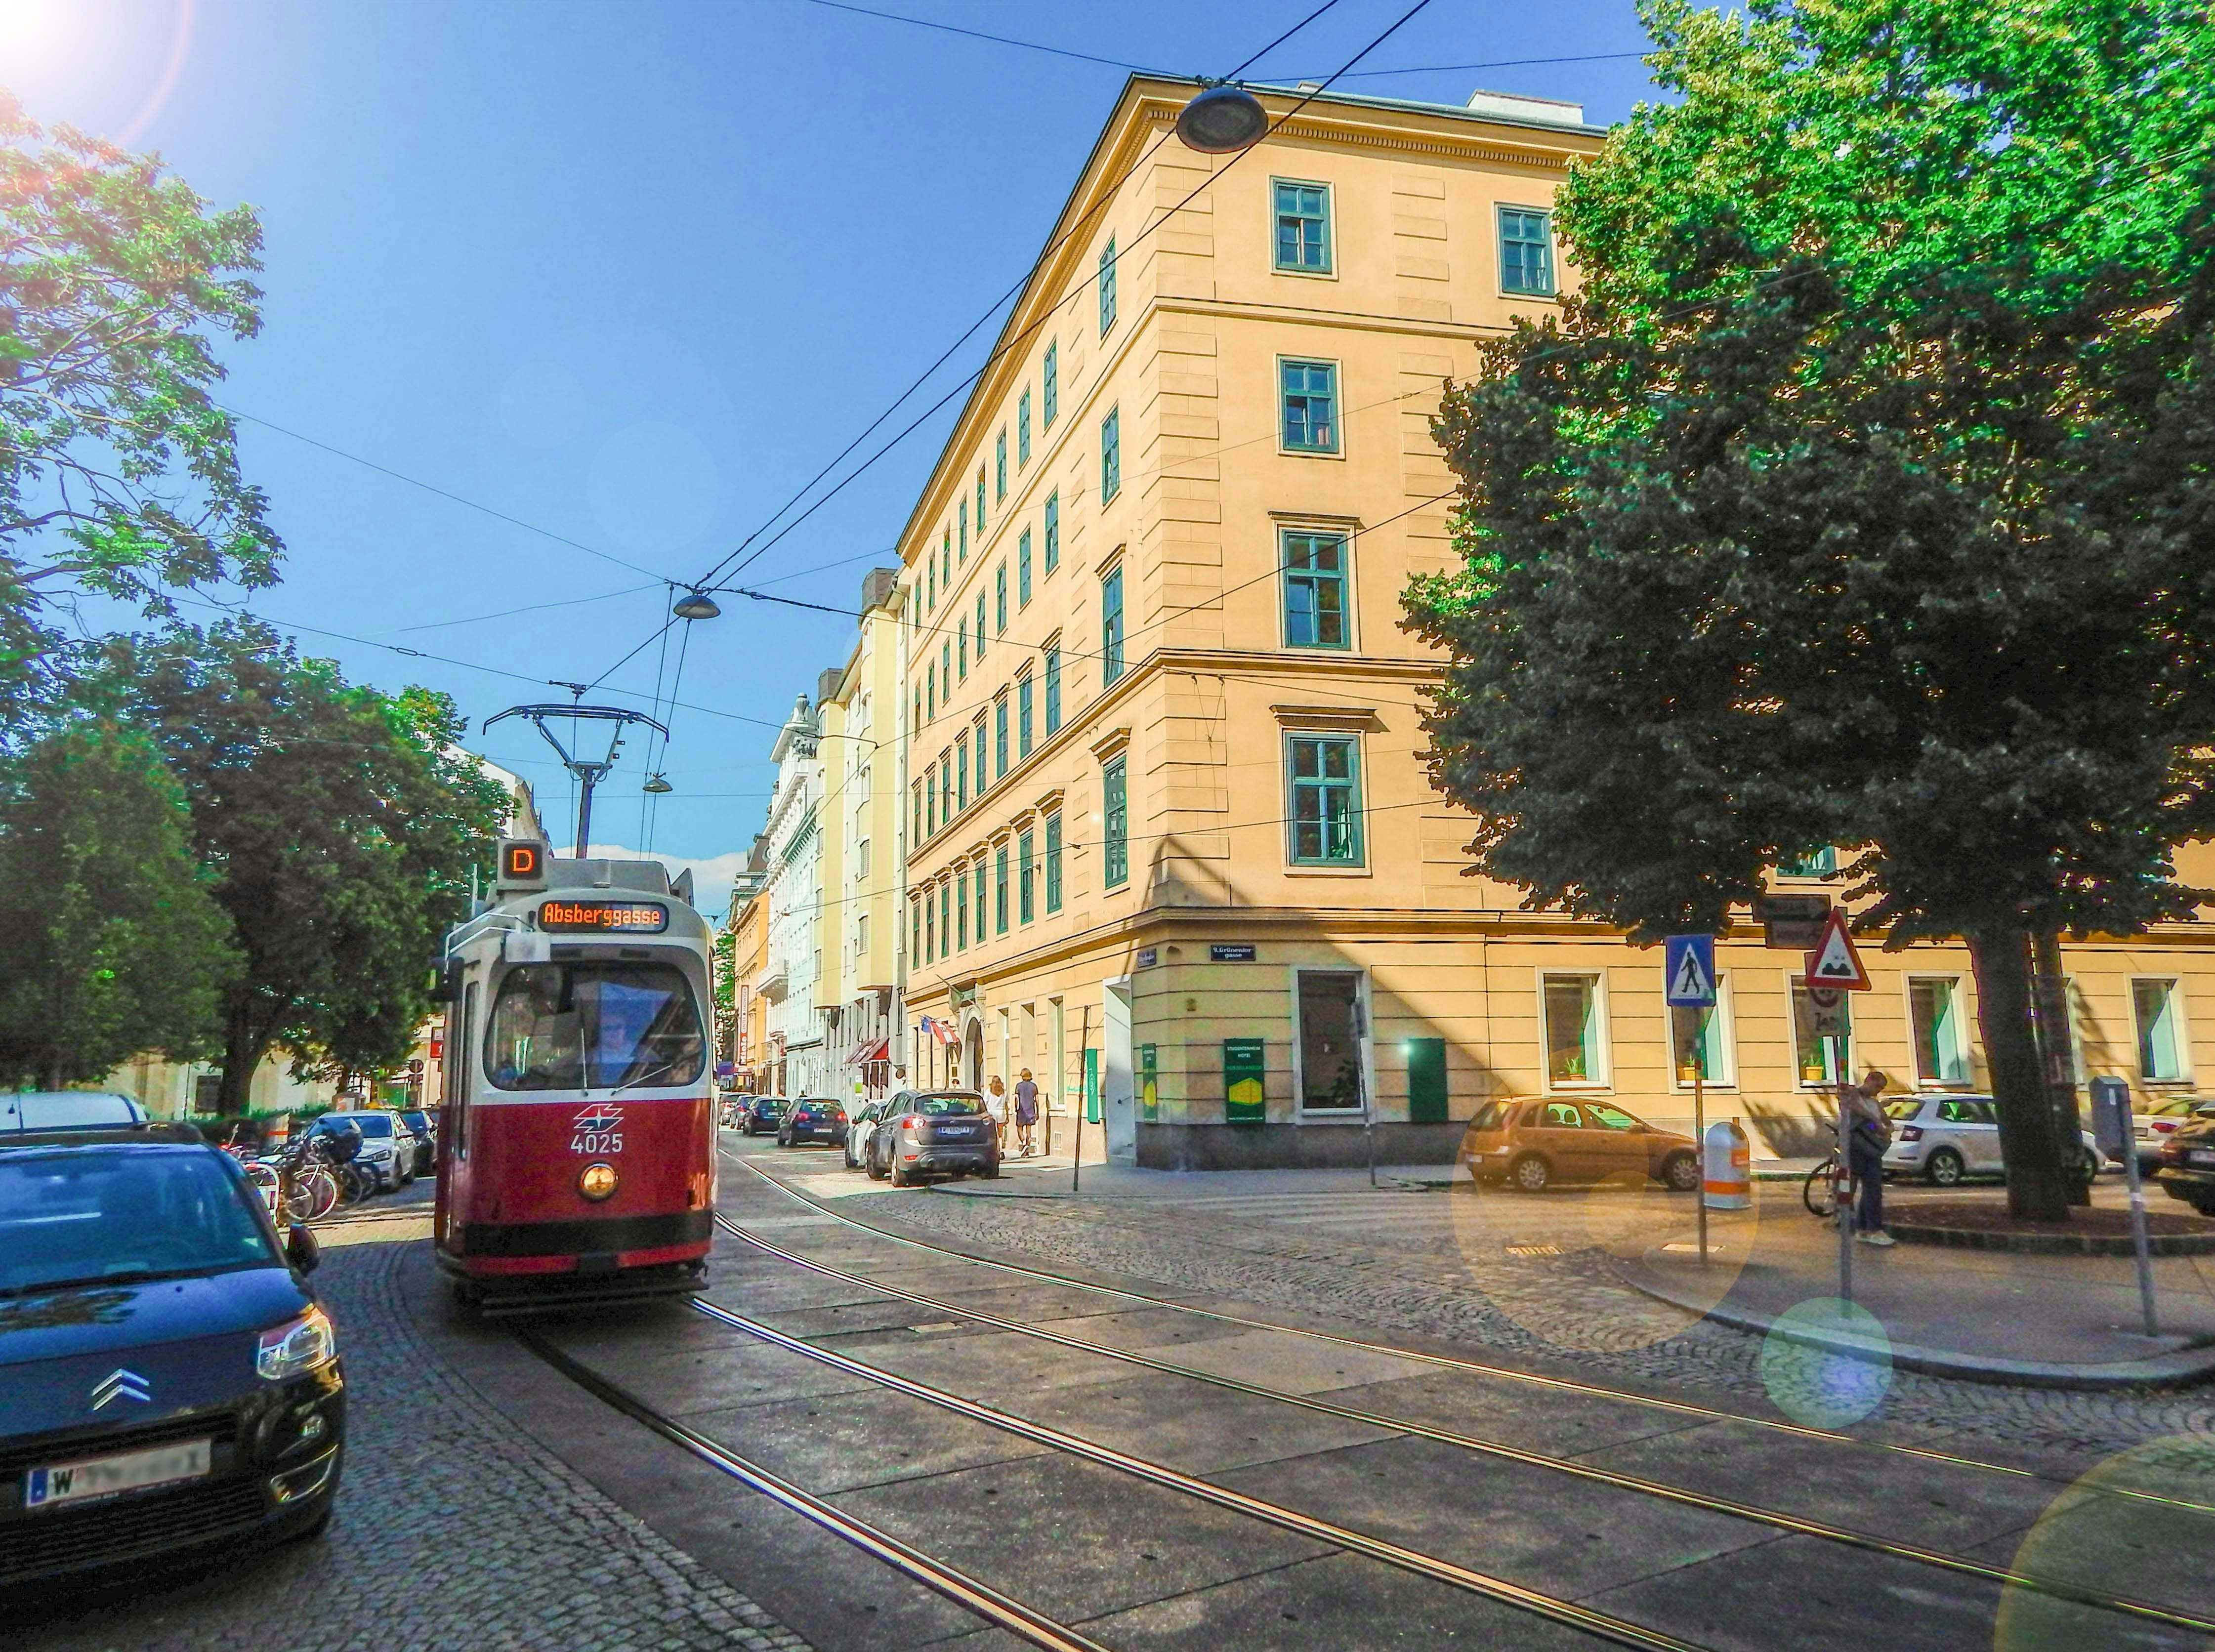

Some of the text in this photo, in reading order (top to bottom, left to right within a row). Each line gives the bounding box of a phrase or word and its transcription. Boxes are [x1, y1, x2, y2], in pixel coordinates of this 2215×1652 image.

[512, 849, 534, 872] D
[544, 903, 661, 927] Absberggasse
[571, 1133, 623, 1154] 4025
[53, 1469, 74, 1494] W
